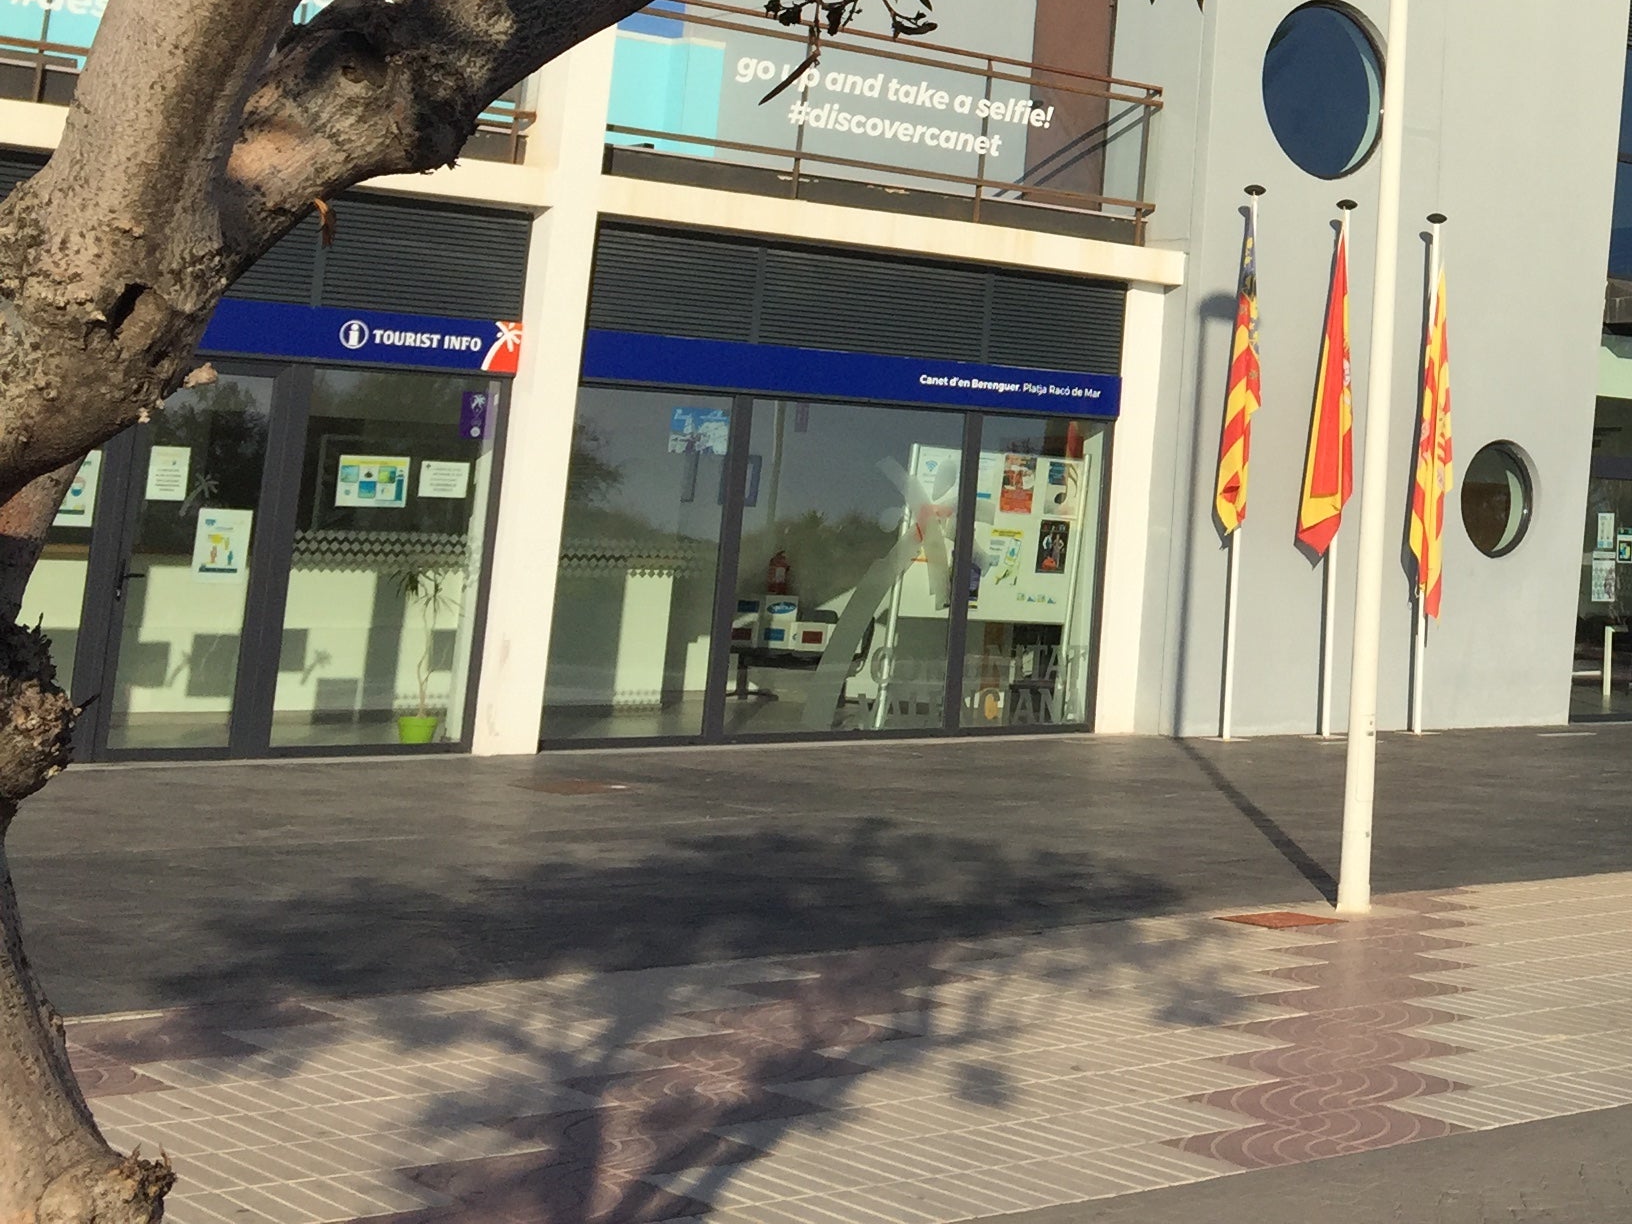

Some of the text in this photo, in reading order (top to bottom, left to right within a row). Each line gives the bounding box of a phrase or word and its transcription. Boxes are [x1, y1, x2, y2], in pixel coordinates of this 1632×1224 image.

[735, 57, 1054, 129] go up and take a selfie!
[788, 100, 1002, 157] #discovercanet
[372, 329, 483, 352] TOURIST INFO
[919, 374, 948, 386] Canet
[949, 376, 970, 387] d'en
[1023, 382, 1047, 396] Platja
[1049, 384, 1070, 396] Racó
[1071, 386, 1083, 396] de
[1084, 388, 1101, 399] Mar
